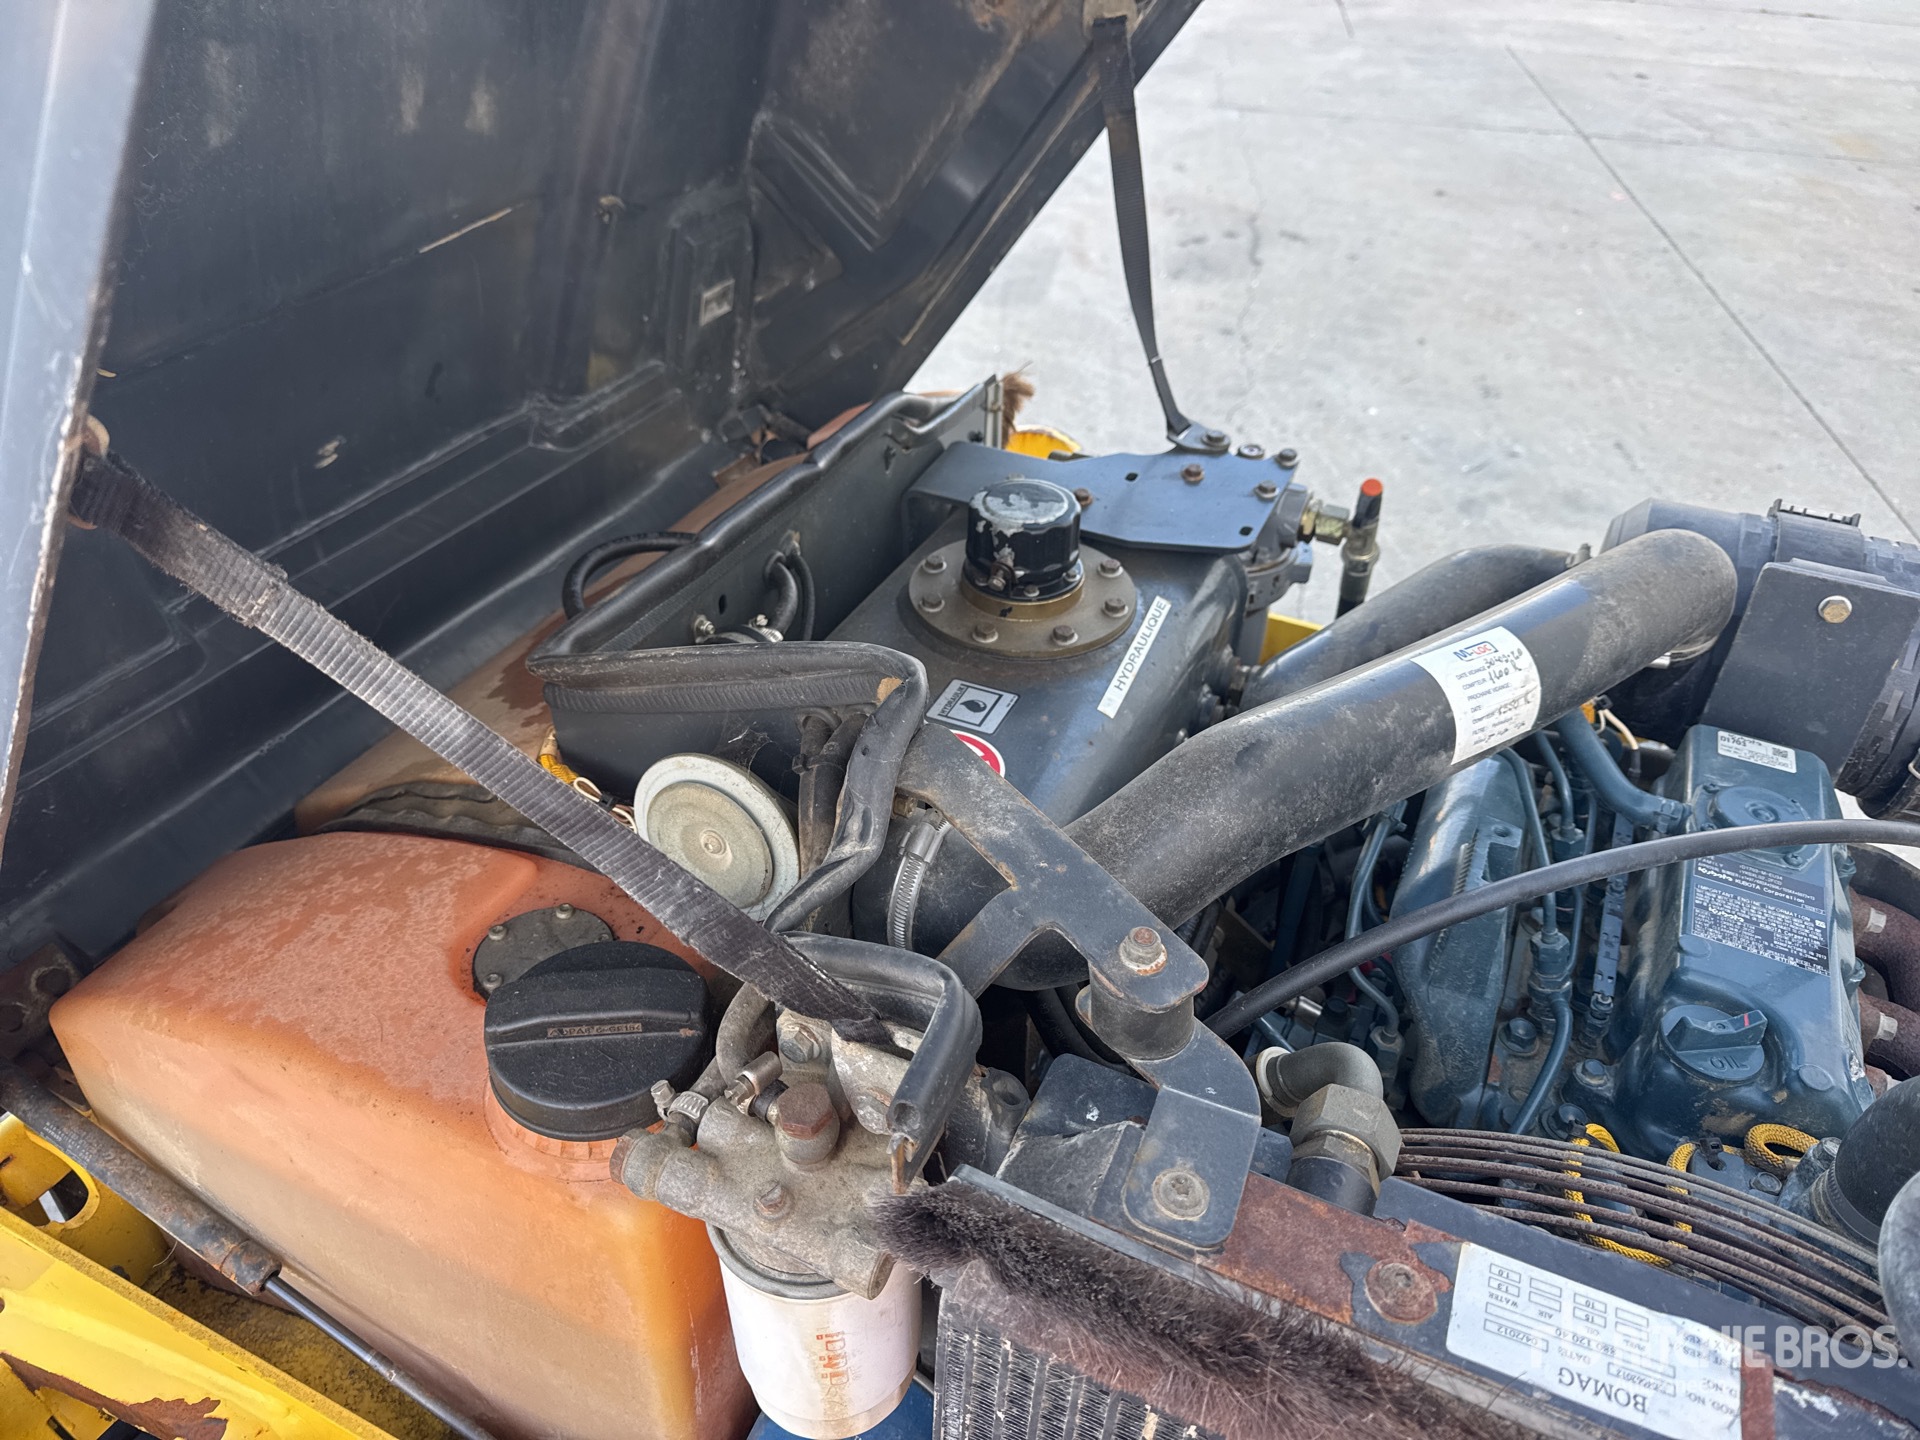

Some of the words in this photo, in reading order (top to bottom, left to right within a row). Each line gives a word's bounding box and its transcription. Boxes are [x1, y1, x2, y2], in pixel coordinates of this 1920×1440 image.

[1114, 601, 1167, 691] HYDRAULIQUE
[1735, 879, 1761, 890] KUBOTA
[1763, 888, 1805, 904] Corporation
[1709, 1055, 1750, 1071] OIL
[1488, 1291, 1518, 1308] WATER
[1585, 1300, 1595, 1310] 10
[1538, 1309, 1553, 1320] AIR
[1584, 1313, 1595, 1324] 15
[1572, 1332, 1592, 1346] 120
[1558, 1367, 1648, 1414] BOMAG
